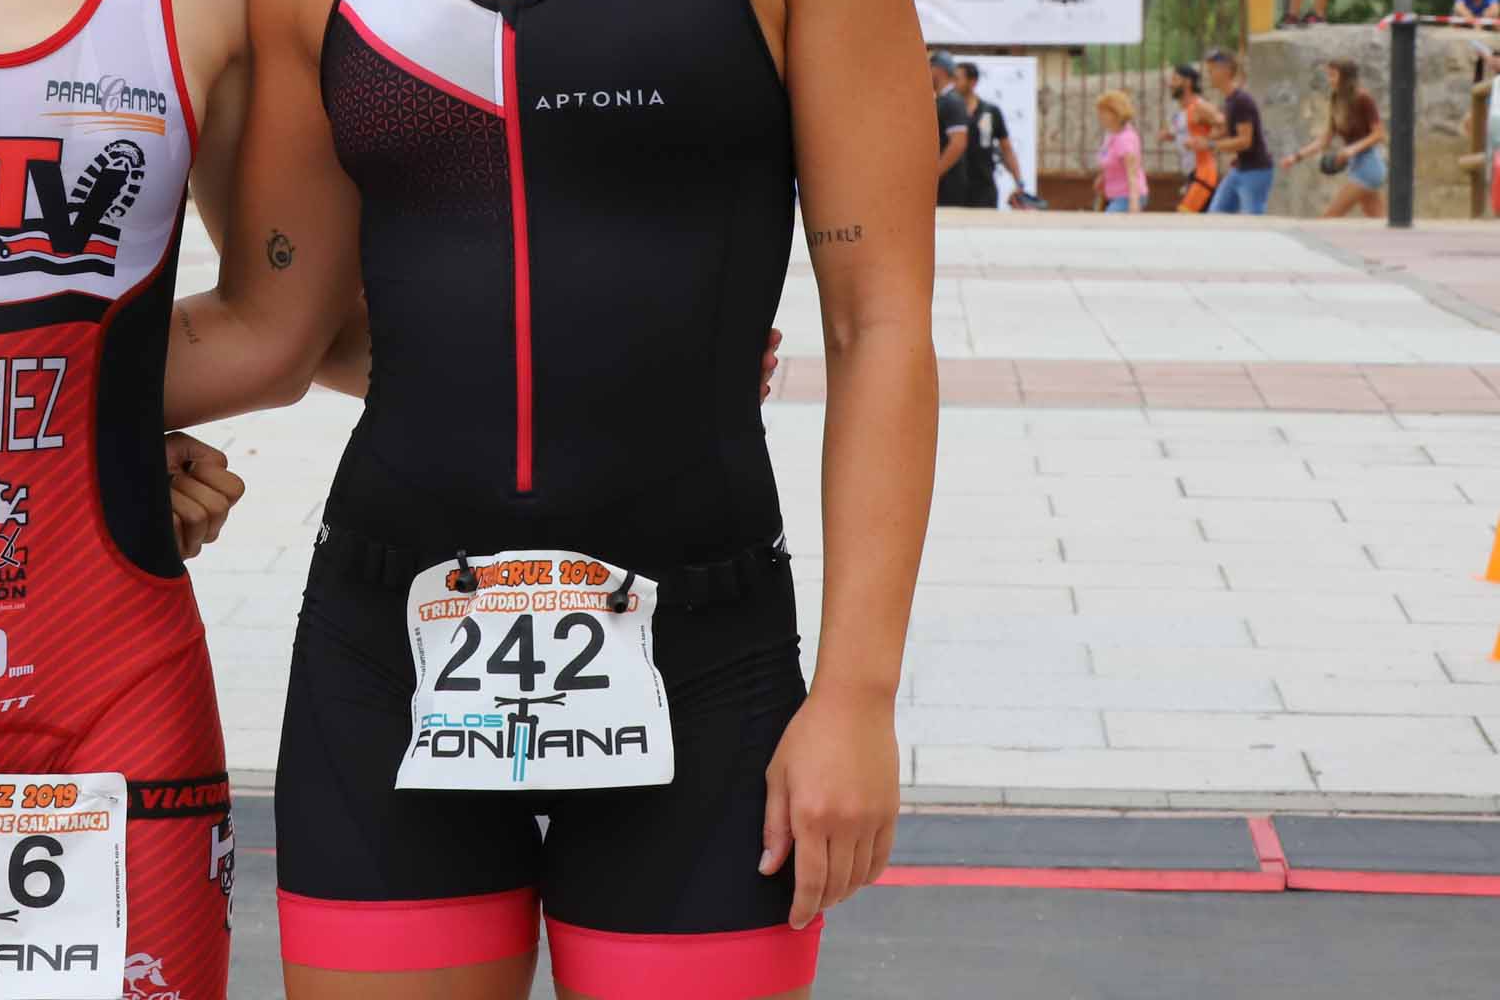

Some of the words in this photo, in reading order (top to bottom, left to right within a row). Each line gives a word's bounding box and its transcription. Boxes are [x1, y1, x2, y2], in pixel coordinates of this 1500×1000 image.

[535, 89, 666, 111] APTONIA
[532, 590, 558, 613] DE
[434, 611, 611, 693] 242
[21, 783, 79, 809] 2019
[17, 811, 110, 834] SALAMANCA
